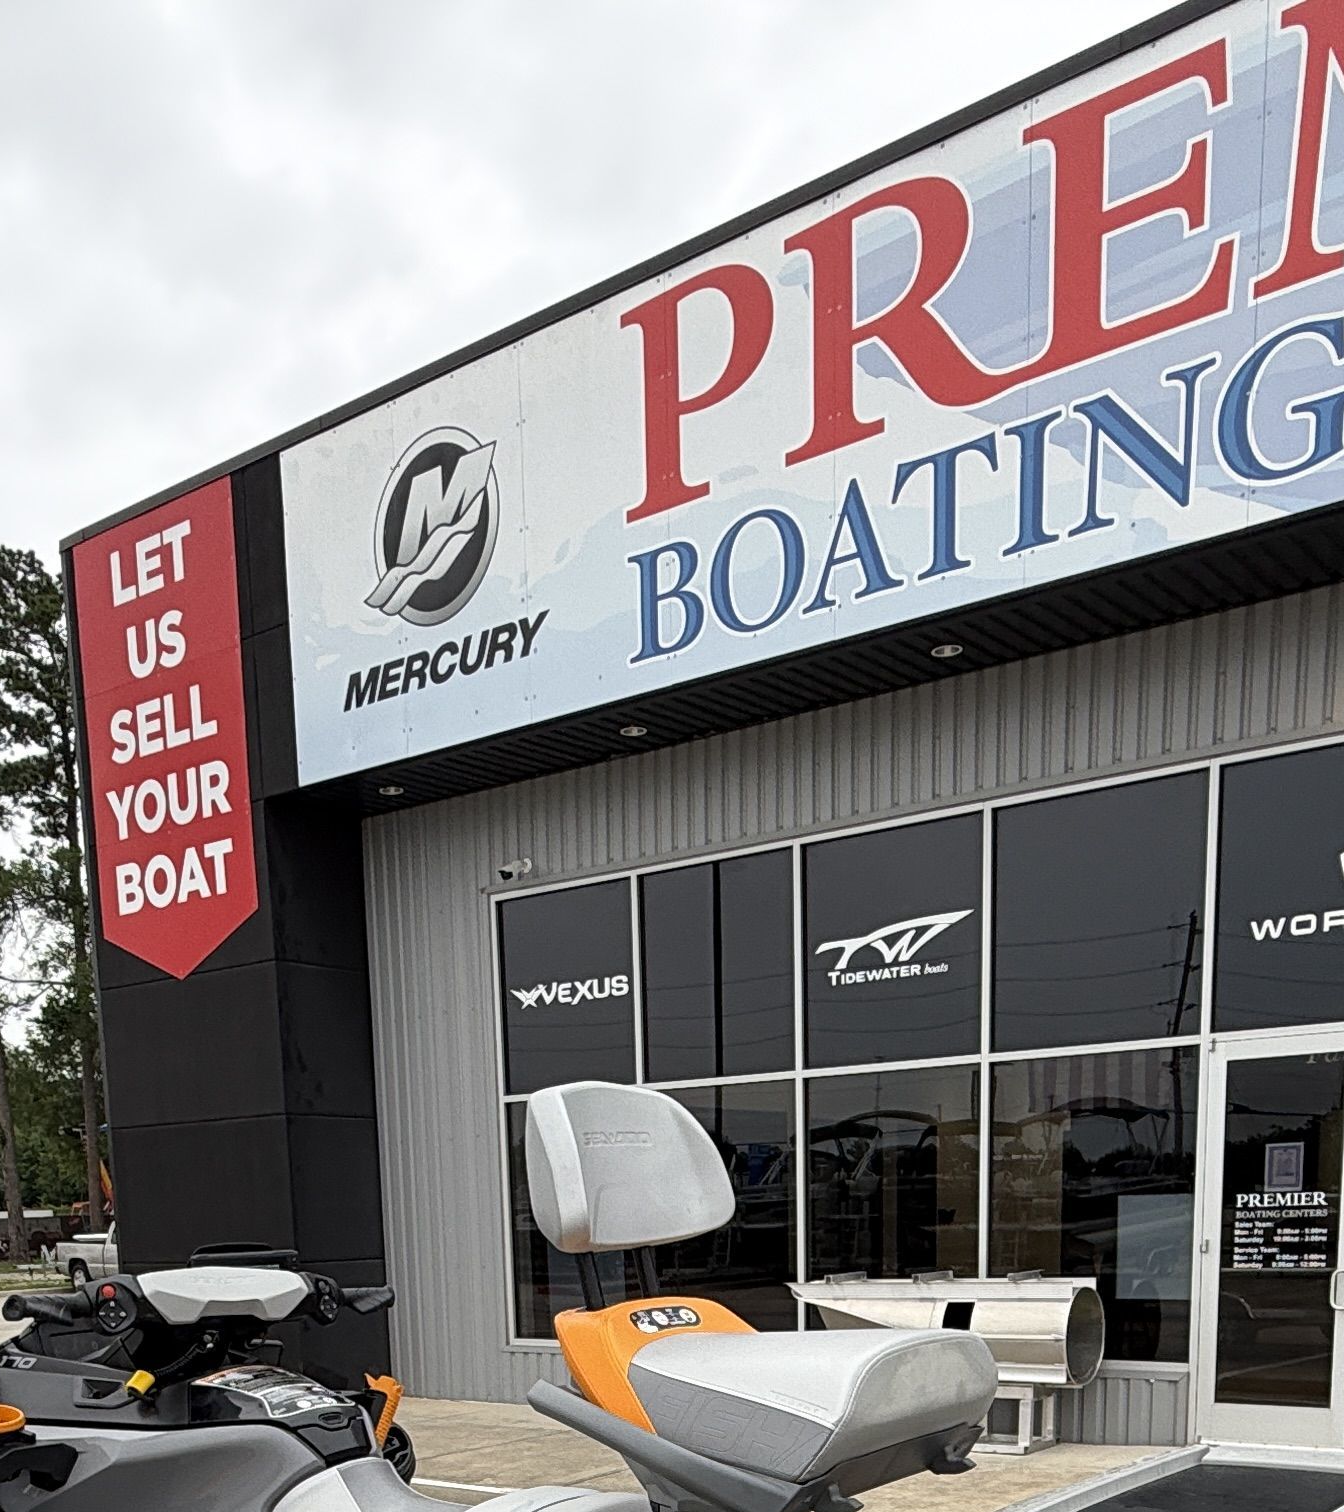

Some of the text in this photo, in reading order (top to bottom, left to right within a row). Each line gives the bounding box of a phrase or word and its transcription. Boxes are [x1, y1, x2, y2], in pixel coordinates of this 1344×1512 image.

[110, 519, 191, 607] LET
[126, 609, 186, 679] US
[343, 609, 550, 713] MERCURY
[110, 684, 218, 764] SELL
[106, 760, 232, 841] YOUR
[115, 837, 233, 916] BOAT
[537, 975, 629, 1005] VEXUS
[828, 962, 948, 986] TIDEWATER boats
[1236, 1192, 1328, 1208] PREMIER
[1236, 1208, 1328, 1219] BOATING CENTERS
[0, 1355, 37, 1369] 170
